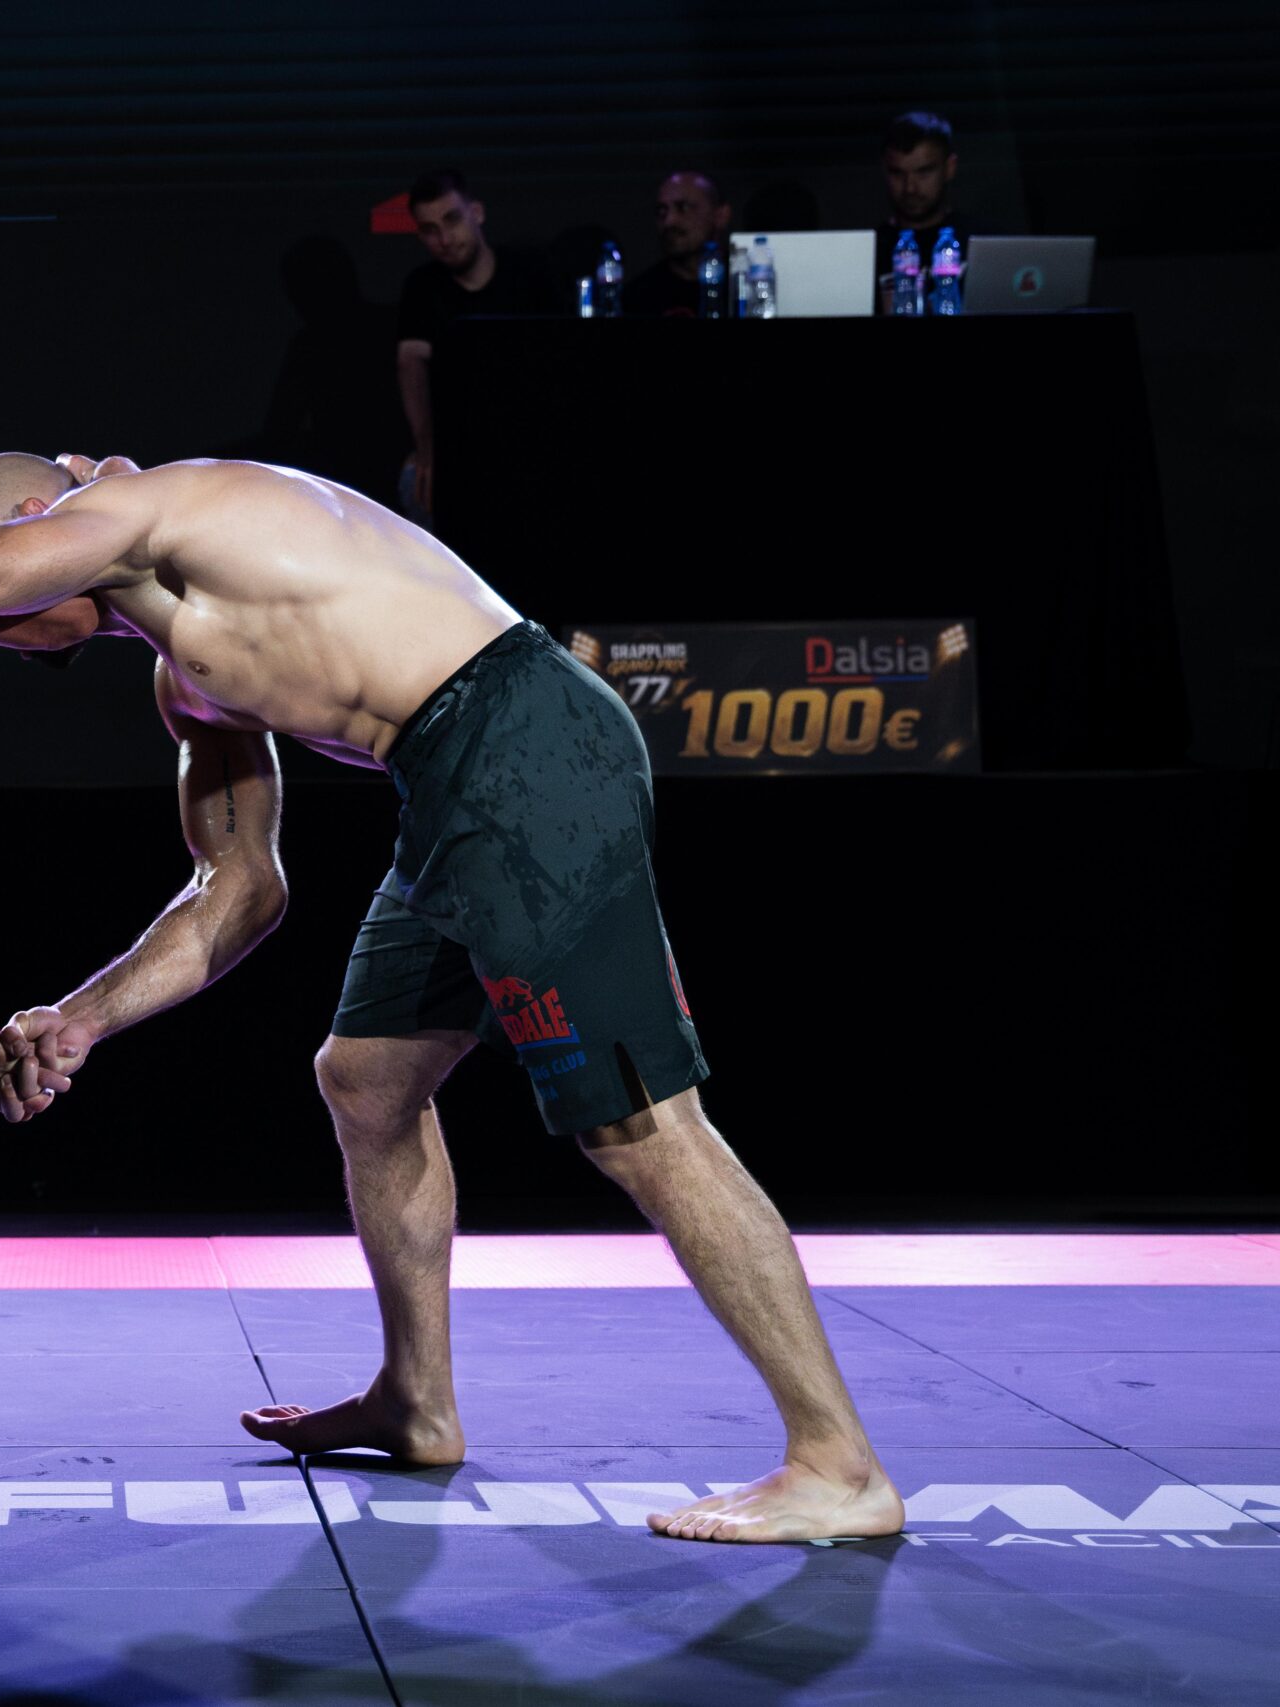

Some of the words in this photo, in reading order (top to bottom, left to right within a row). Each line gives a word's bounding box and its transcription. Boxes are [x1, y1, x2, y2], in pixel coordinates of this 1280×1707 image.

[610, 642, 688, 660] GRAPPLING
[805, 636, 931, 674] Dalsia
[627, 675, 672, 706] 77
[552, 1049, 587, 1076] CLUB
